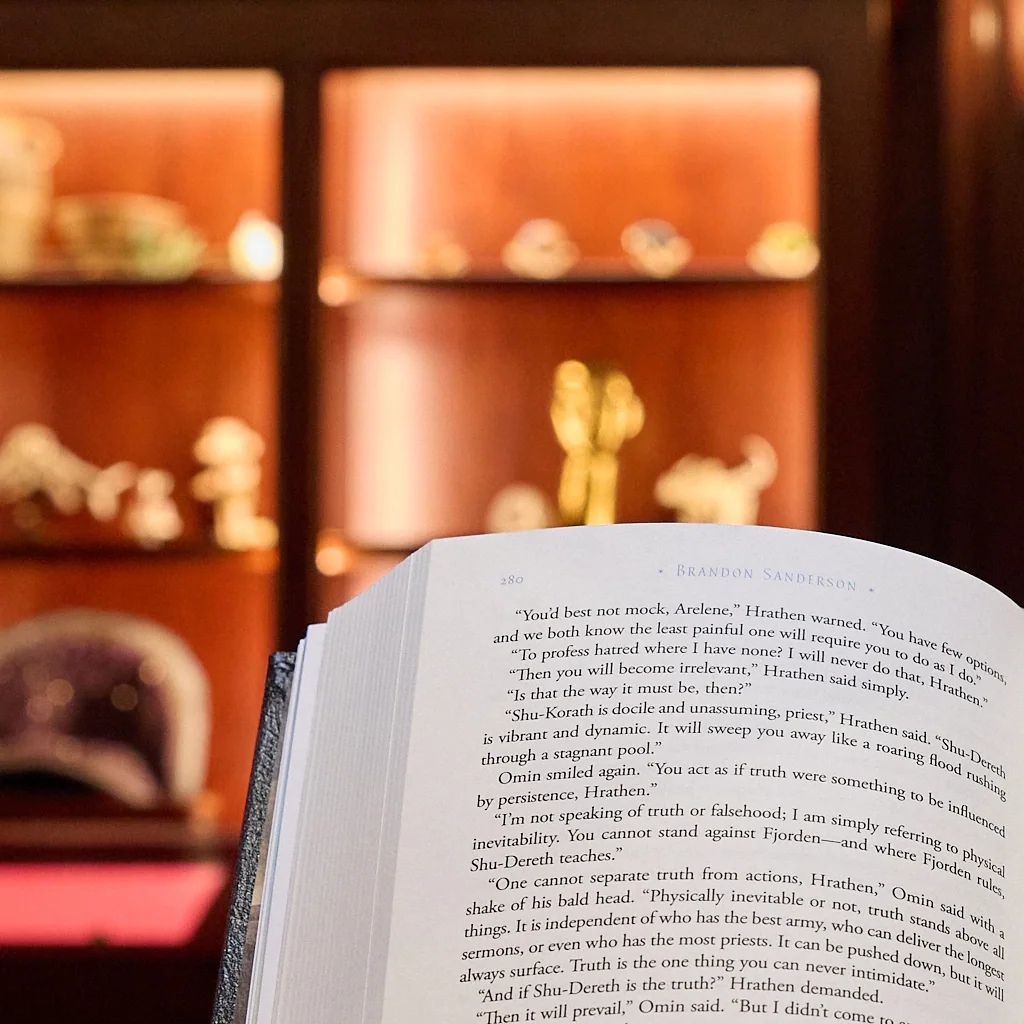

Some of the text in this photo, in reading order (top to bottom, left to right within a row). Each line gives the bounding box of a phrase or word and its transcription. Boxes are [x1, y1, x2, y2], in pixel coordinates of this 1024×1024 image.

[501, 575, 524, 585] 280
[677, 564, 856, 591] BRANDON SANDERSON
[564, 606, 592, 619] best
[596, 607, 620, 617] not
[624, 602, 670, 617] mock,
[745, 605, 806, 622] Hrathen
[810, 615, 866, 632] warned.
[908, 630, 938, 651] have
[941, 641, 963, 660] few
[966, 656, 1007, 686] options,
[530, 686, 559, 700] that
[563, 684, 585, 700] the
[590, 686, 619, 699] way
[621, 683, 633, 695] it
[637, 685, 674, 694] must
[678, 680, 699, 695] be,
[481, 748, 536, 767] through
[541, 751, 549, 761] a
[553, 747, 614, 763] stagnant
[477, 794, 495, 811] by
[497, 791, 579, 810] persistence,
[470, 851, 554, 872] Shu-Dereth
[533, 874, 584, 888] cannot
[589, 872, 650, 887] separate
[657, 866, 694, 881] truth
[702, 866, 738, 881] from
[745, 870, 803, 886] actions,
[891, 886, 935, 909] Omin
[939, 903, 965, 919] said
[970, 913, 996, 935] with
[999, 930, 1005, 940] a
